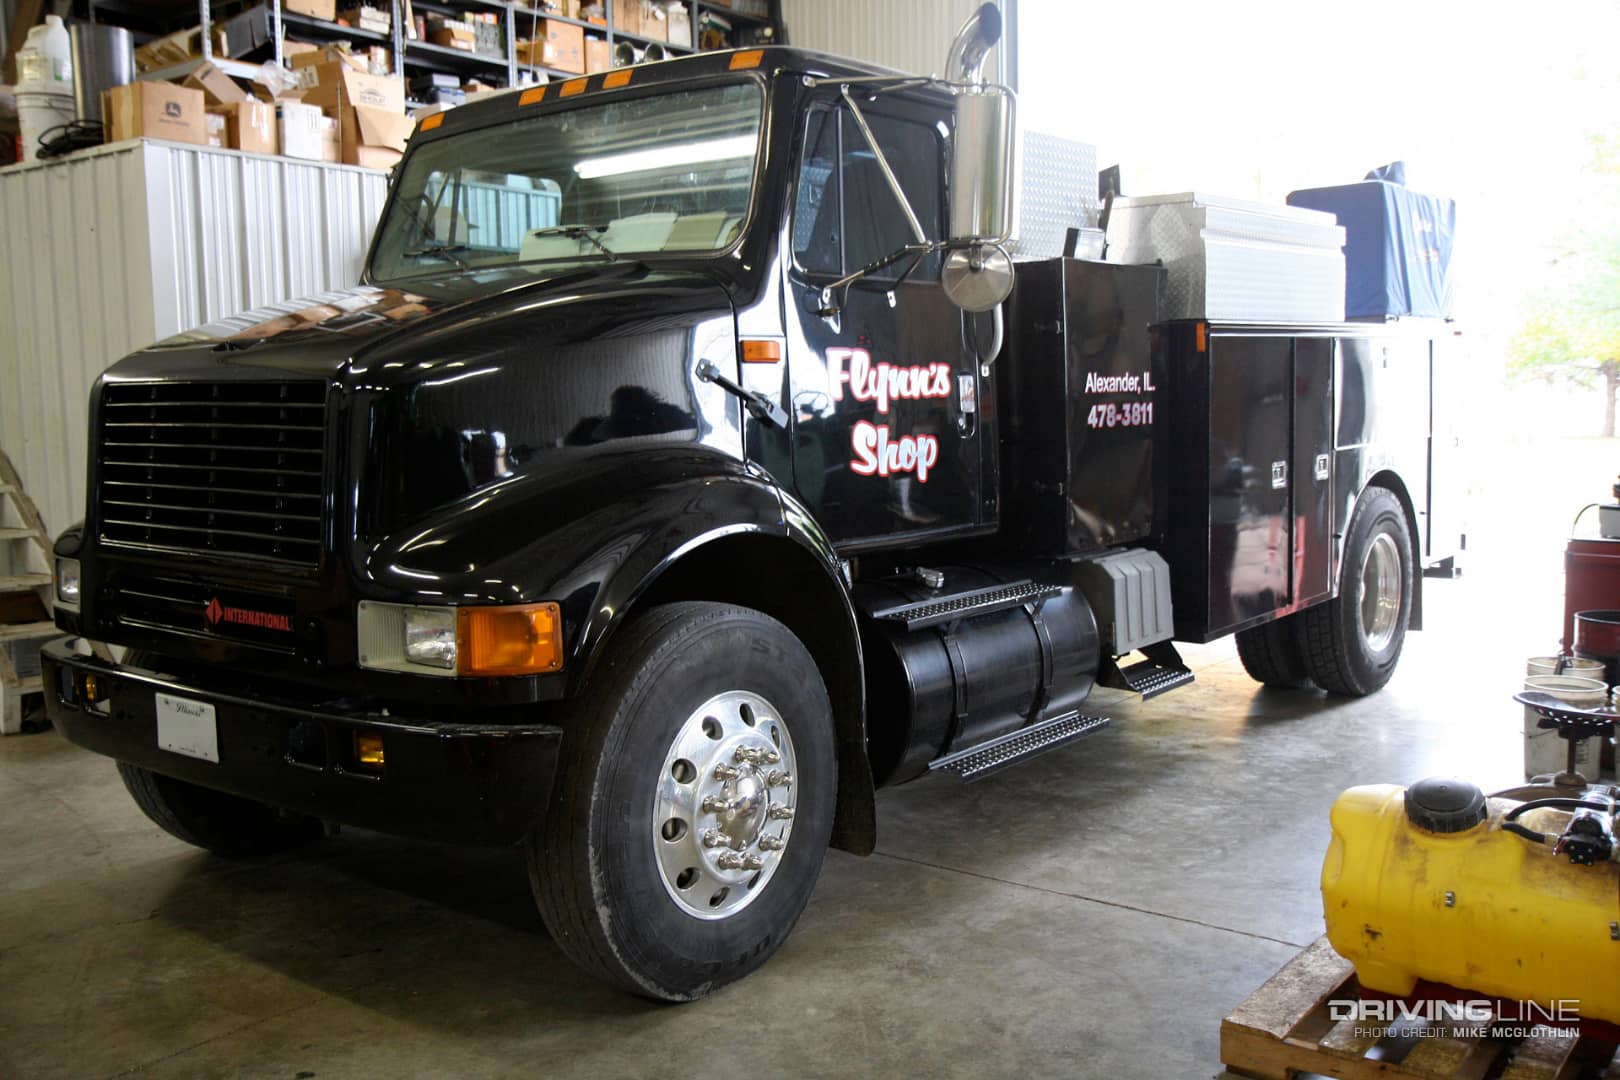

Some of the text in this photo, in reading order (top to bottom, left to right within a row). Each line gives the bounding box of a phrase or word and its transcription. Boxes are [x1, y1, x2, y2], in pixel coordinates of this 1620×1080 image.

[825, 347, 950, 413] Flynn's
[1085, 372, 1141, 395] Alexander,
[1087, 403, 1153, 428] 478-3811
[850, 420, 938, 482] Shop
[224, 607, 290, 631] INTERNATIONAL
